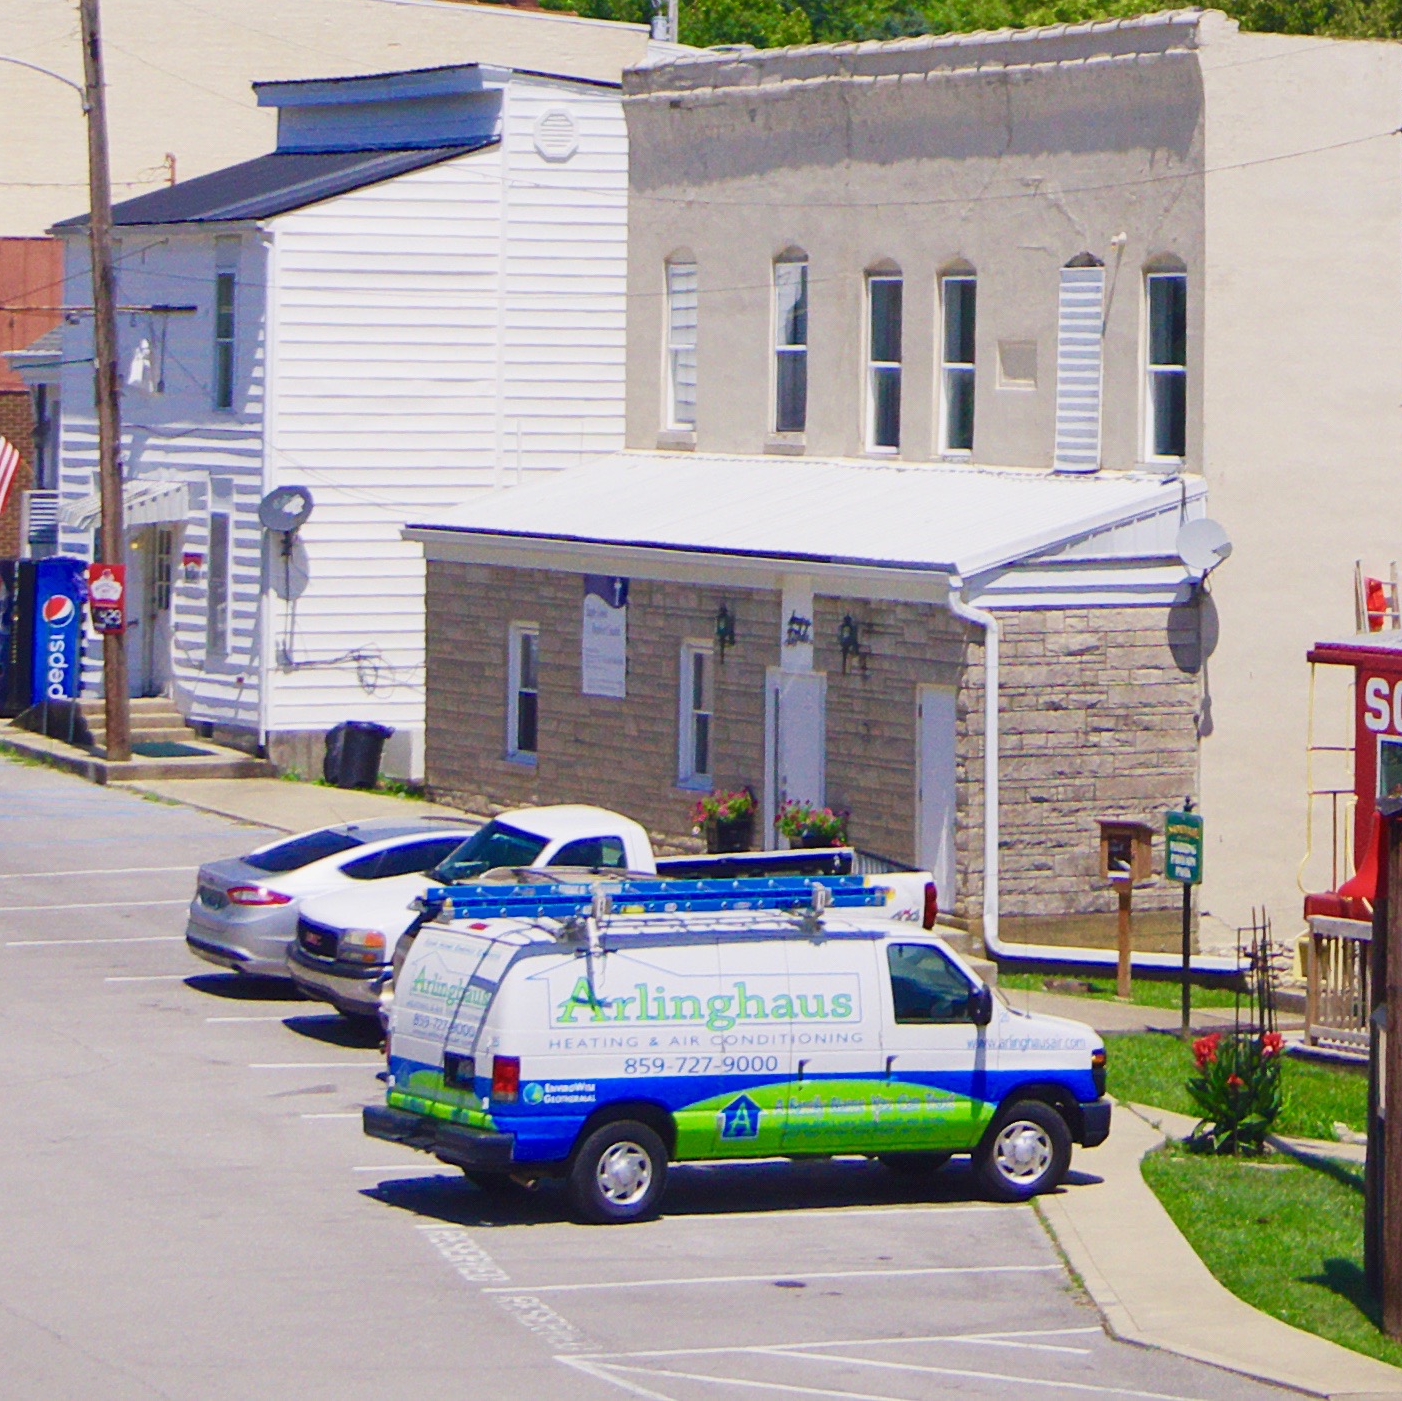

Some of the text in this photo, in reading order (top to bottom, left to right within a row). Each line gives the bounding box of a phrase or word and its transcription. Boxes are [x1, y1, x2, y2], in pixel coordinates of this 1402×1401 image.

[47, 632, 69, 699] pepsi
[556, 976, 854, 1031] Arlinghaus
[549, 1032, 863, 1049] HEATING & AIR CONDITIONING
[624, 1054, 778, 1075] 859-727-9000
